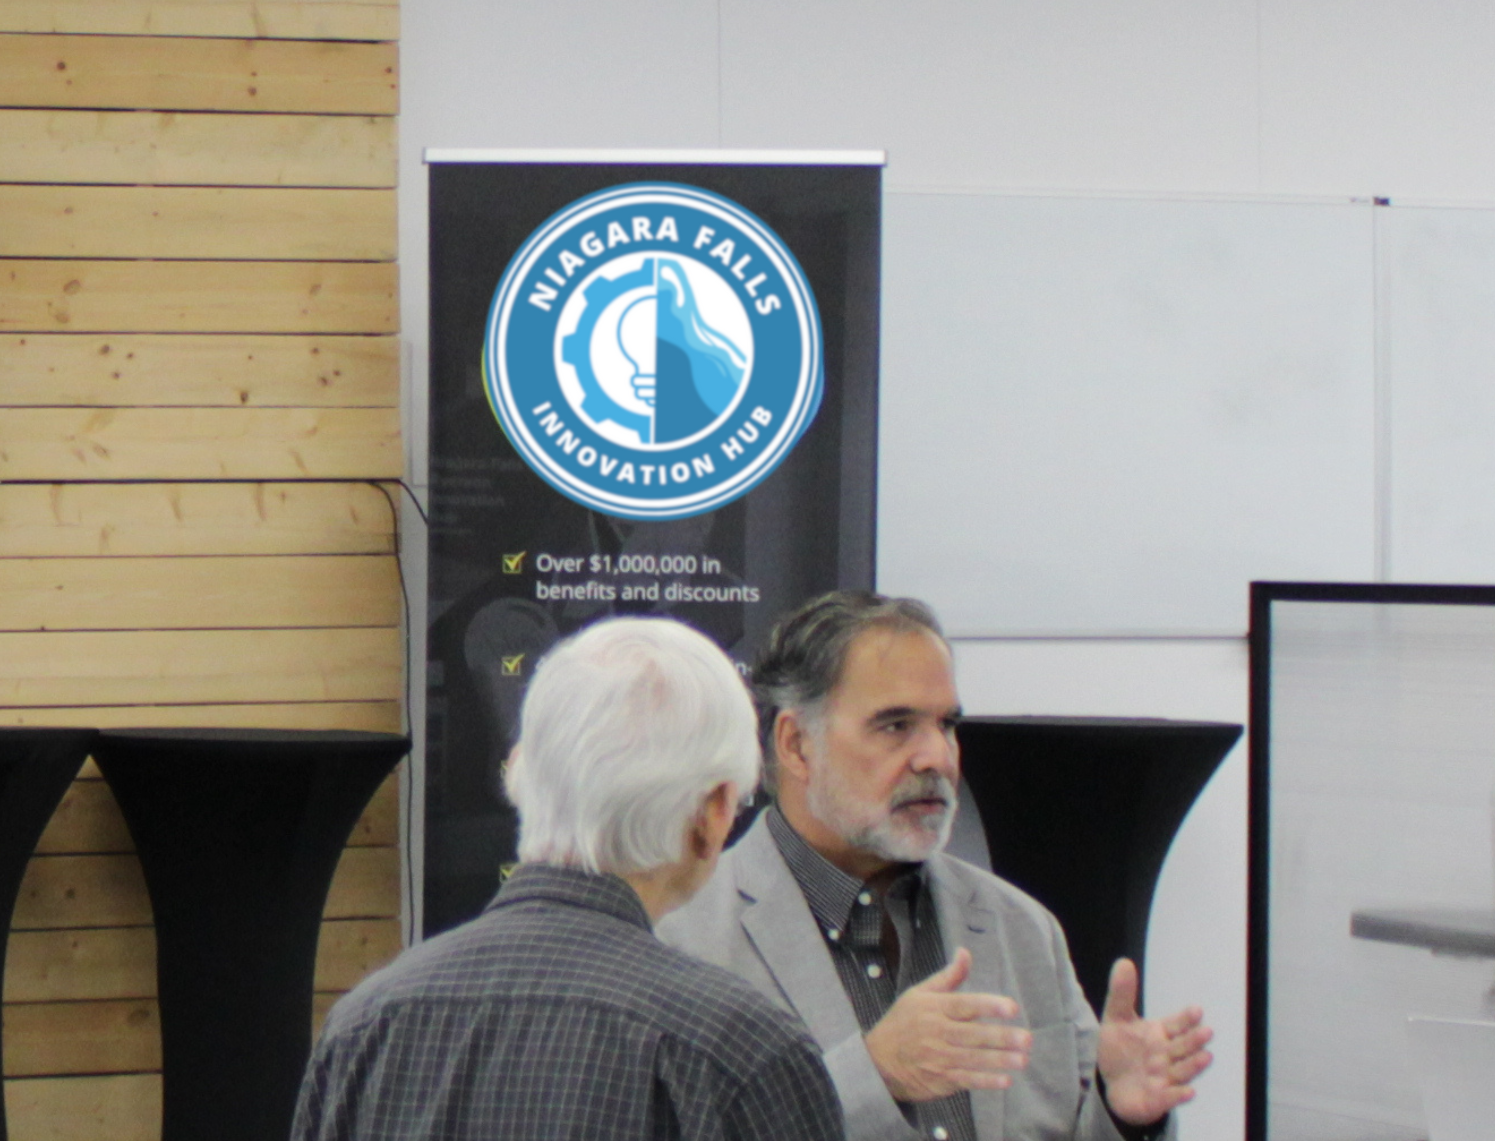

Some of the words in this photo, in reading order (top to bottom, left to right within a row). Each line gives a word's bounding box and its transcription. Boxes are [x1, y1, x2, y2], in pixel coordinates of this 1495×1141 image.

[528, 216, 679, 312] NIAGARA
[693, 225, 782, 316] FALLS
[532, 400, 716, 486] INNOVATION
[720, 405, 775, 461] HUB
[536, 553, 584, 574] Over
[589, 554, 697, 576] $1,000,000
[702, 555, 721, 575] in
[536, 580, 616, 601] benefits
[621, 582, 659, 602] and
[664, 583, 760, 603] discounts
